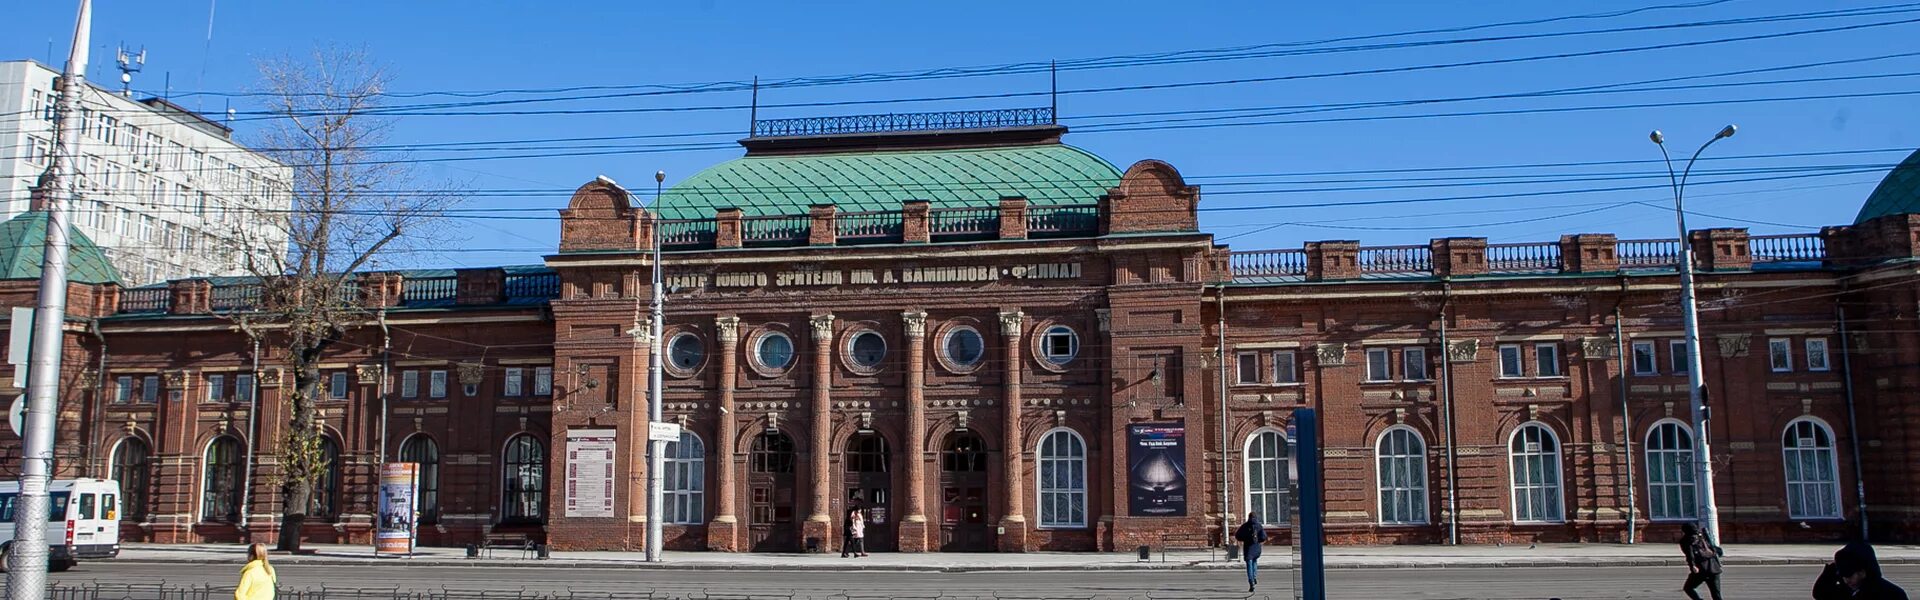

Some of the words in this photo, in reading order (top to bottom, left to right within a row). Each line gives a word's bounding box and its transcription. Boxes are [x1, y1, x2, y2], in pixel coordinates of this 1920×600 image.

[665, 273, 708, 288] ТЕАТР
[716, 271, 768, 287] ЮНОГО
[776, 270, 842, 286] ЗРИТЕЛЯ
[851, 269, 878, 284] ИМ.
[883, 268, 898, 283] А.
[903, 266, 999, 283] ВАМПИЛОВА
[1012, 262, 1081, 279] ФИЛИАЛ
